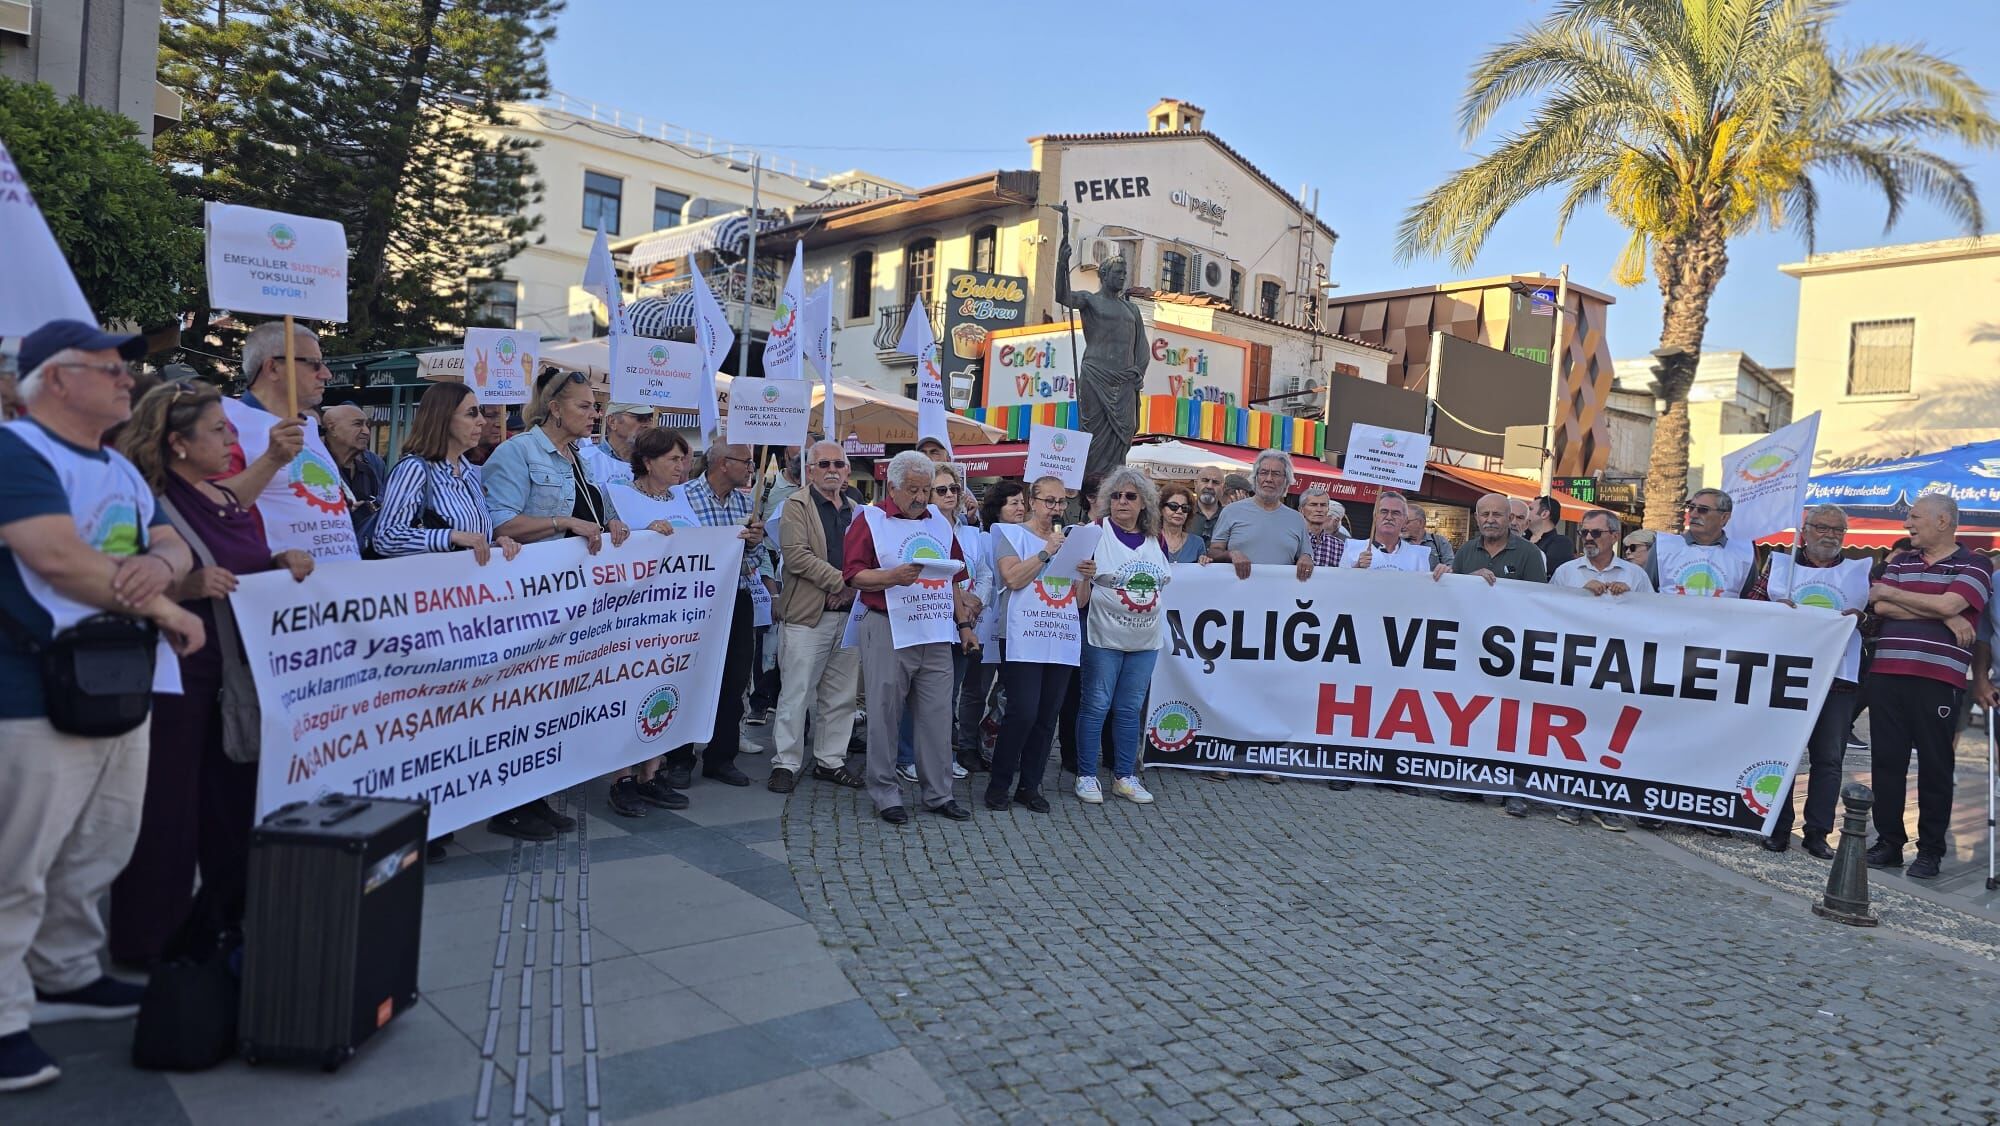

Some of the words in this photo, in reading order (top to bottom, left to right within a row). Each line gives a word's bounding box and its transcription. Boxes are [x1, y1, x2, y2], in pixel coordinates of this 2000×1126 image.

[1075, 176, 1151, 203] PEKER
[223, 253, 288, 270] EMEKLİLER
[290, 262, 341, 278] SUSTUKÇA
[249, 270, 316, 286] YOKSULLUK
[952, 274, 1025, 302] Bubble
[640, 388, 651, 396] BİZ
[648, 378, 664, 387] İÇİN
[290, 521, 318, 533] TÜM
[307, 543, 352, 558] NTALYA
[271, 592, 408, 636] KENARDAN
[520, 564, 587, 597] HAYDİ
[592, 563, 627, 586] SEN
[632, 559, 658, 580] DE
[658, 554, 715, 574] KATIL
[901, 594, 920, 604] TÜM
[917, 601, 951, 612] SENDİKAS
[907, 612, 942, 622] ANTALYA
[1023, 609, 1038, 618] TÜM
[1034, 620, 1070, 630] SENDİKASI
[269, 638, 357, 677] insanca
[362, 628, 444, 660] yaşam
[448, 608, 560, 642] haklarımız
[565, 603, 587, 620] ve
[592, 582, 687, 616] taleplerimiz
[694, 581, 716, 598] ile
[503, 638, 547, 658] onurlu
[550, 632, 567, 646] bir
[569, 620, 612, 645] gelecek
[616, 610, 677, 629] bırakmak
[682, 607, 705, 625] için
[1167, 598, 1361, 675] AÇLIĞA
[1382, 616, 1459, 672] VE
[1478, 625, 1813, 711] SEFALETE
[352, 700, 369, 716] ve
[374, 678, 468, 709] demokratik
[472, 673, 492, 689] bir
[497, 653, 559, 682] TÜRKİYE
[563, 637, 631, 667] mücadelesi
[375, 694, 486, 742] YAŞAMAK
[1315, 683, 1642, 769] HAYIR!
[353, 765, 395, 797] TÜM
[401, 724, 529, 783] EMEKLİLERİN
[535, 699, 626, 740] SENDİKASI
[406, 768, 493, 806] NTALYA
[498, 740, 562, 787] ŞUBESİ
[1195, 741, 1236, 763] TÜM
[1246, 747, 1383, 773] EMEKLİLERİN
[1396, 758, 1514, 786] SENDİKASI
[1525, 771, 1631, 804] ANTALYA
[1644, 787, 1736, 818] ŞUBESİ
